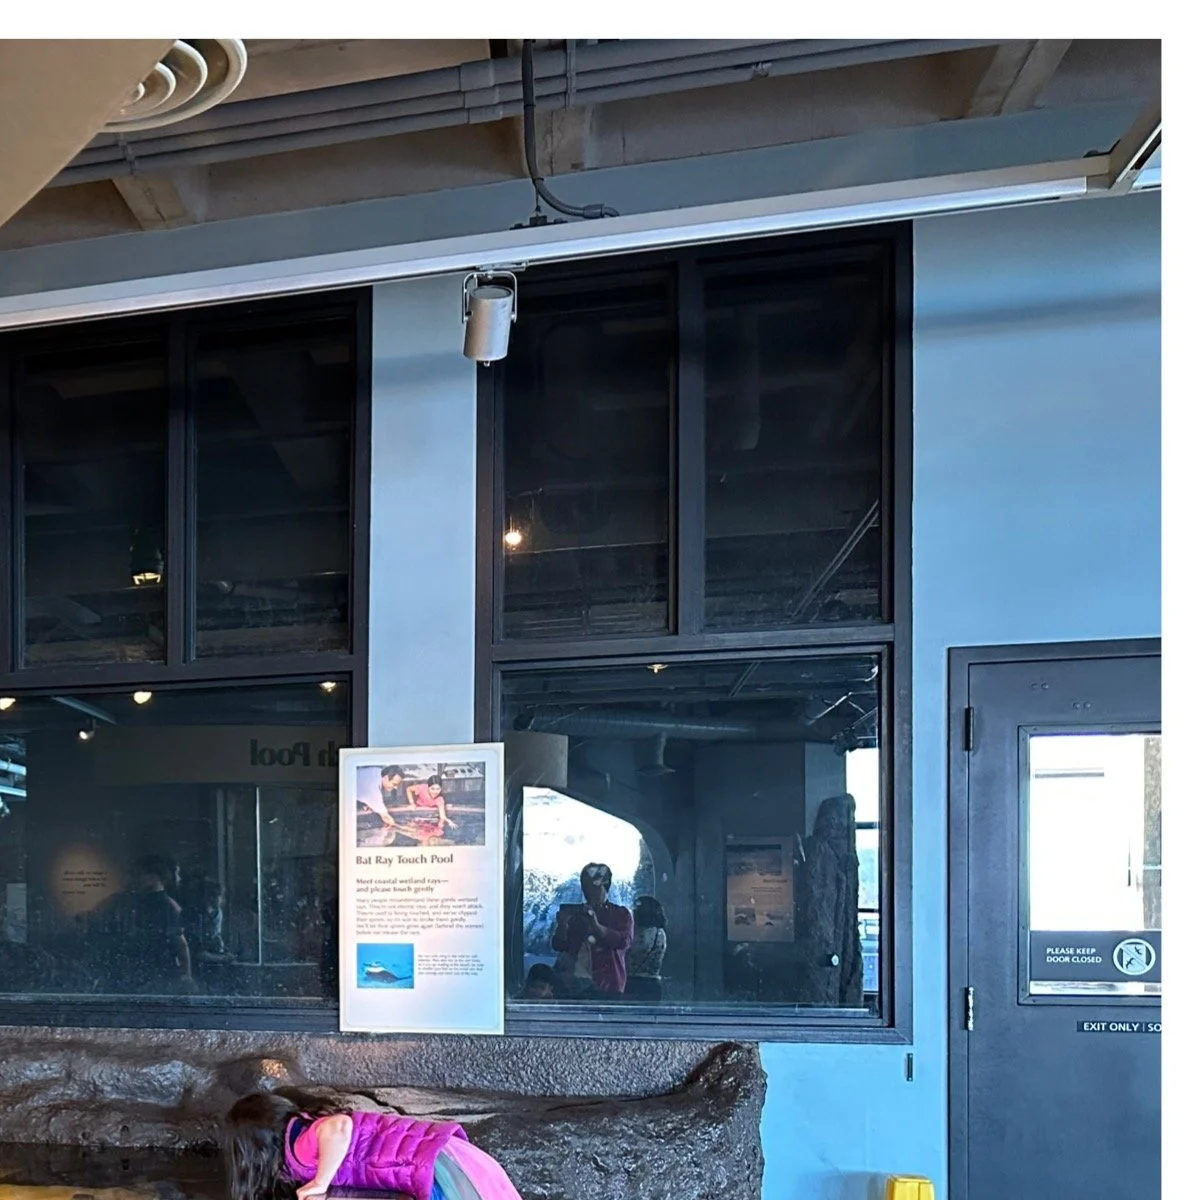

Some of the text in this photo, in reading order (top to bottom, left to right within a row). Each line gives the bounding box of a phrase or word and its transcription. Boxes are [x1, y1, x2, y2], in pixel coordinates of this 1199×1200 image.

[356, 853, 454, 868] Bat Ray Touch Pool
[1046, 956, 1103, 964] DOOR CLOSED
[1083, 1022, 1108, 1031] EXIT
[1109, 1022, 1140, 1032] ONLY
